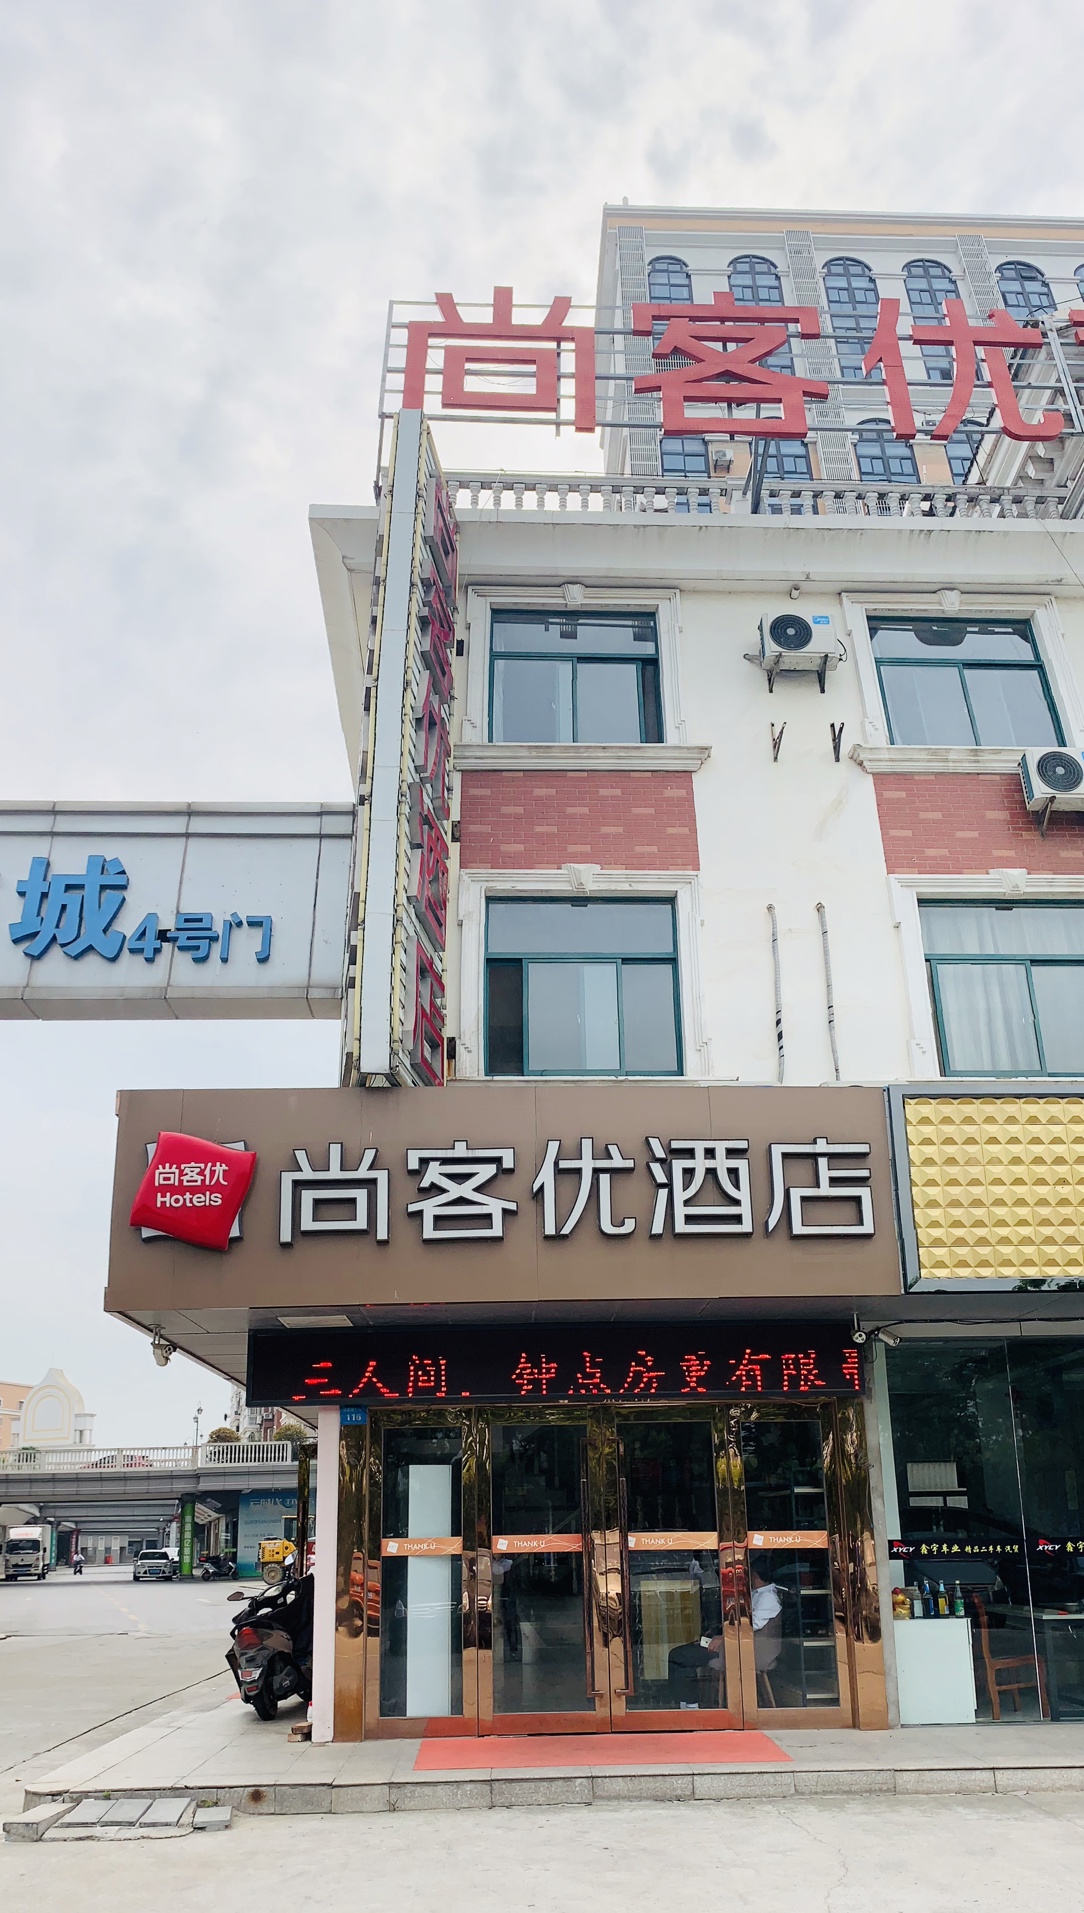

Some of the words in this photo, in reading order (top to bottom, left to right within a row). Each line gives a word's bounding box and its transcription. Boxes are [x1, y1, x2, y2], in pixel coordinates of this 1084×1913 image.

[402, 286, 1084, 442] 尚客优
[154, 1161, 229, 1186] 尚客优
[156, 1190, 222, 1208] Hotels
[278, 1136, 876, 1246] 尚客优酒店
[513, 1540, 538, 1548] THANK
[539, 1540, 546, 1548] U
